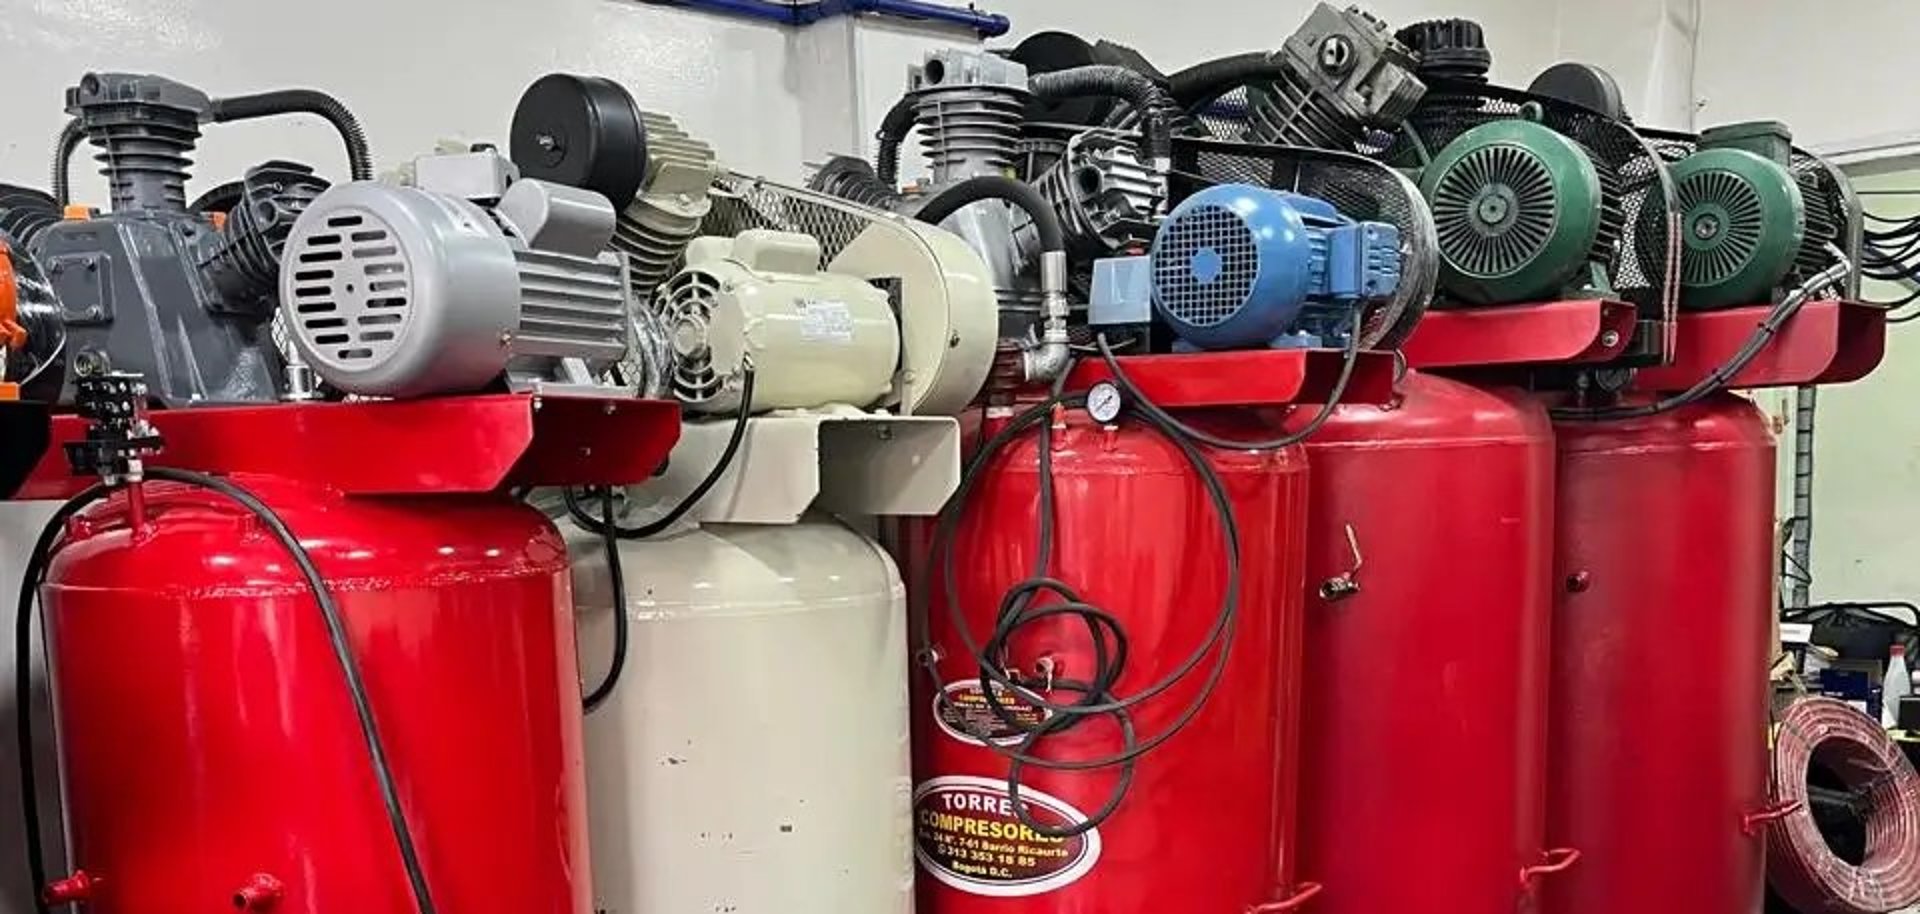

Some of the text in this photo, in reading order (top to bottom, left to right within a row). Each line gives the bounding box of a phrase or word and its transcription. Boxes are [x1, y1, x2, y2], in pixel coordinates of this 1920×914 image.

[947, 845, 967, 858] 313
[970, 848, 994, 863] 353
[982, 840, 1015, 853] Barrio
[1017, 844, 1069, 857] Ricaurte
[989, 866, 1013, 878] D.C.
